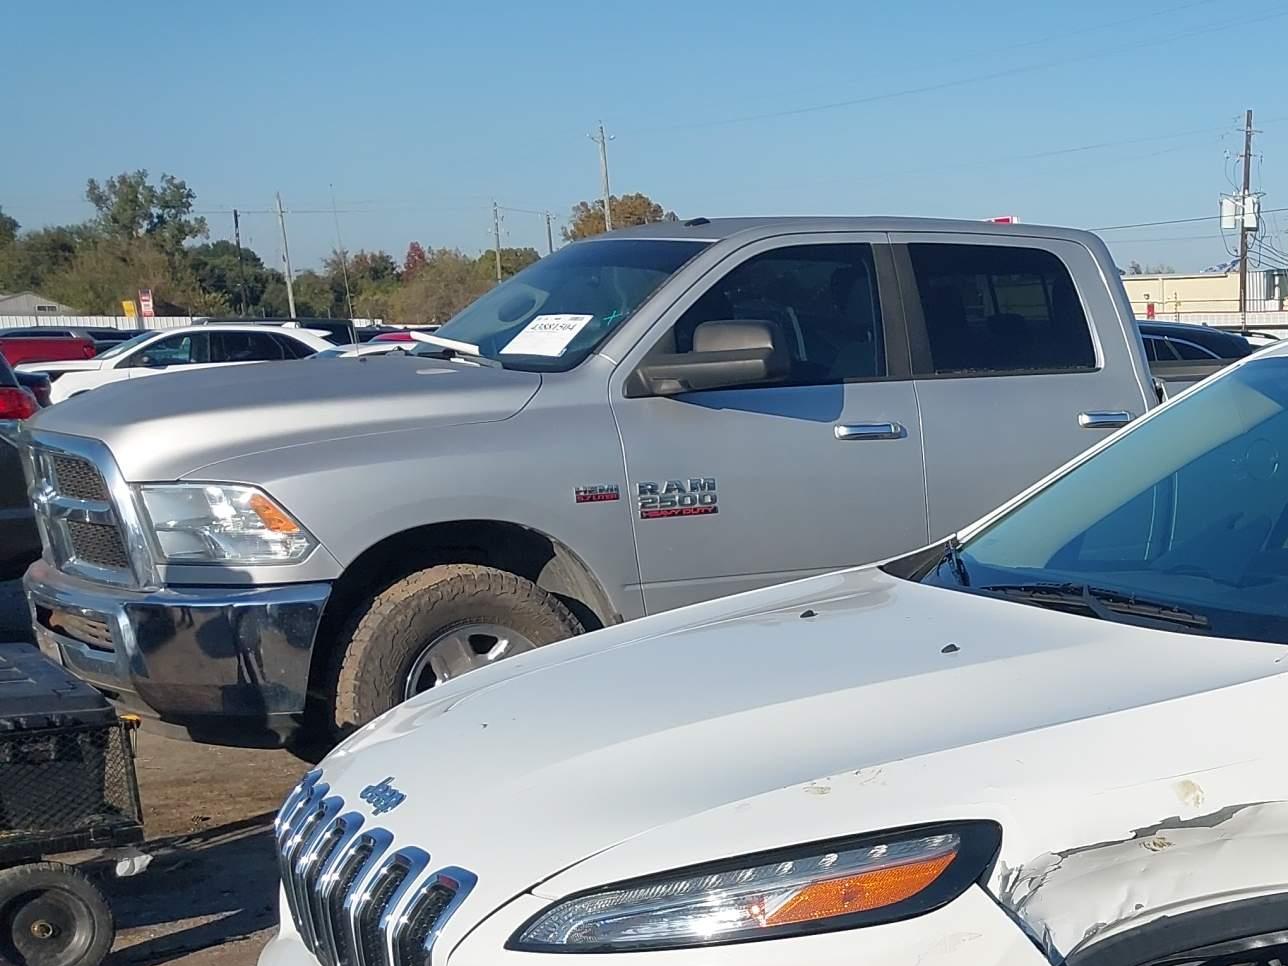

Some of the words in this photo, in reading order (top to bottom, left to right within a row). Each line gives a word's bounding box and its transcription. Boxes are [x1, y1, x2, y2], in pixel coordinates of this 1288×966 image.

[637, 478, 716, 495] RAM
[639, 493, 717, 509] 2500
[642, 508, 680, 518] HEAVY
[682, 506, 713, 515] DUTY
